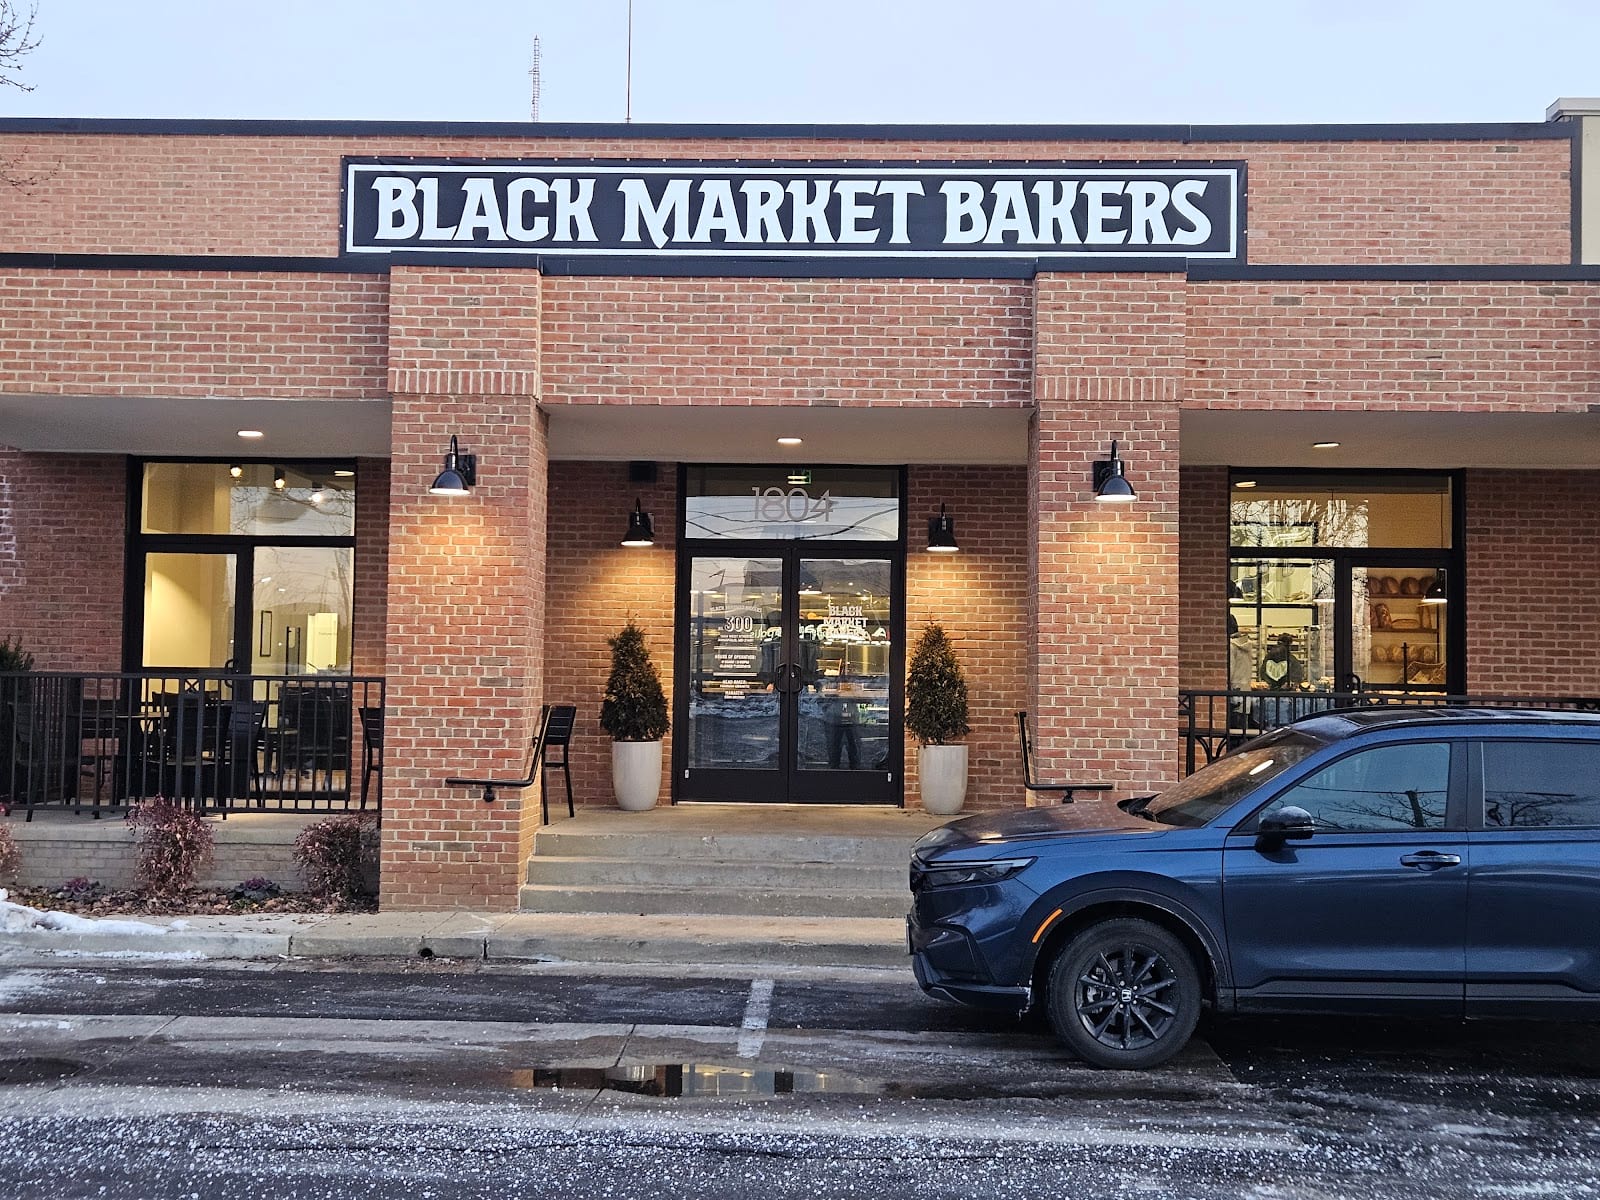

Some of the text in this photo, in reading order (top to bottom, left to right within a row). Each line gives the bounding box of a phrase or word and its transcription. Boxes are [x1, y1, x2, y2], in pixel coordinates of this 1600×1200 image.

[371, 176, 1212, 250] BLACK MARKET BAKERS
[751, 486, 834, 522] 1804
[828, 605, 863, 616] BLACK
[724, 615, 753, 632] 300
[823, 616, 869, 628] MARKET
